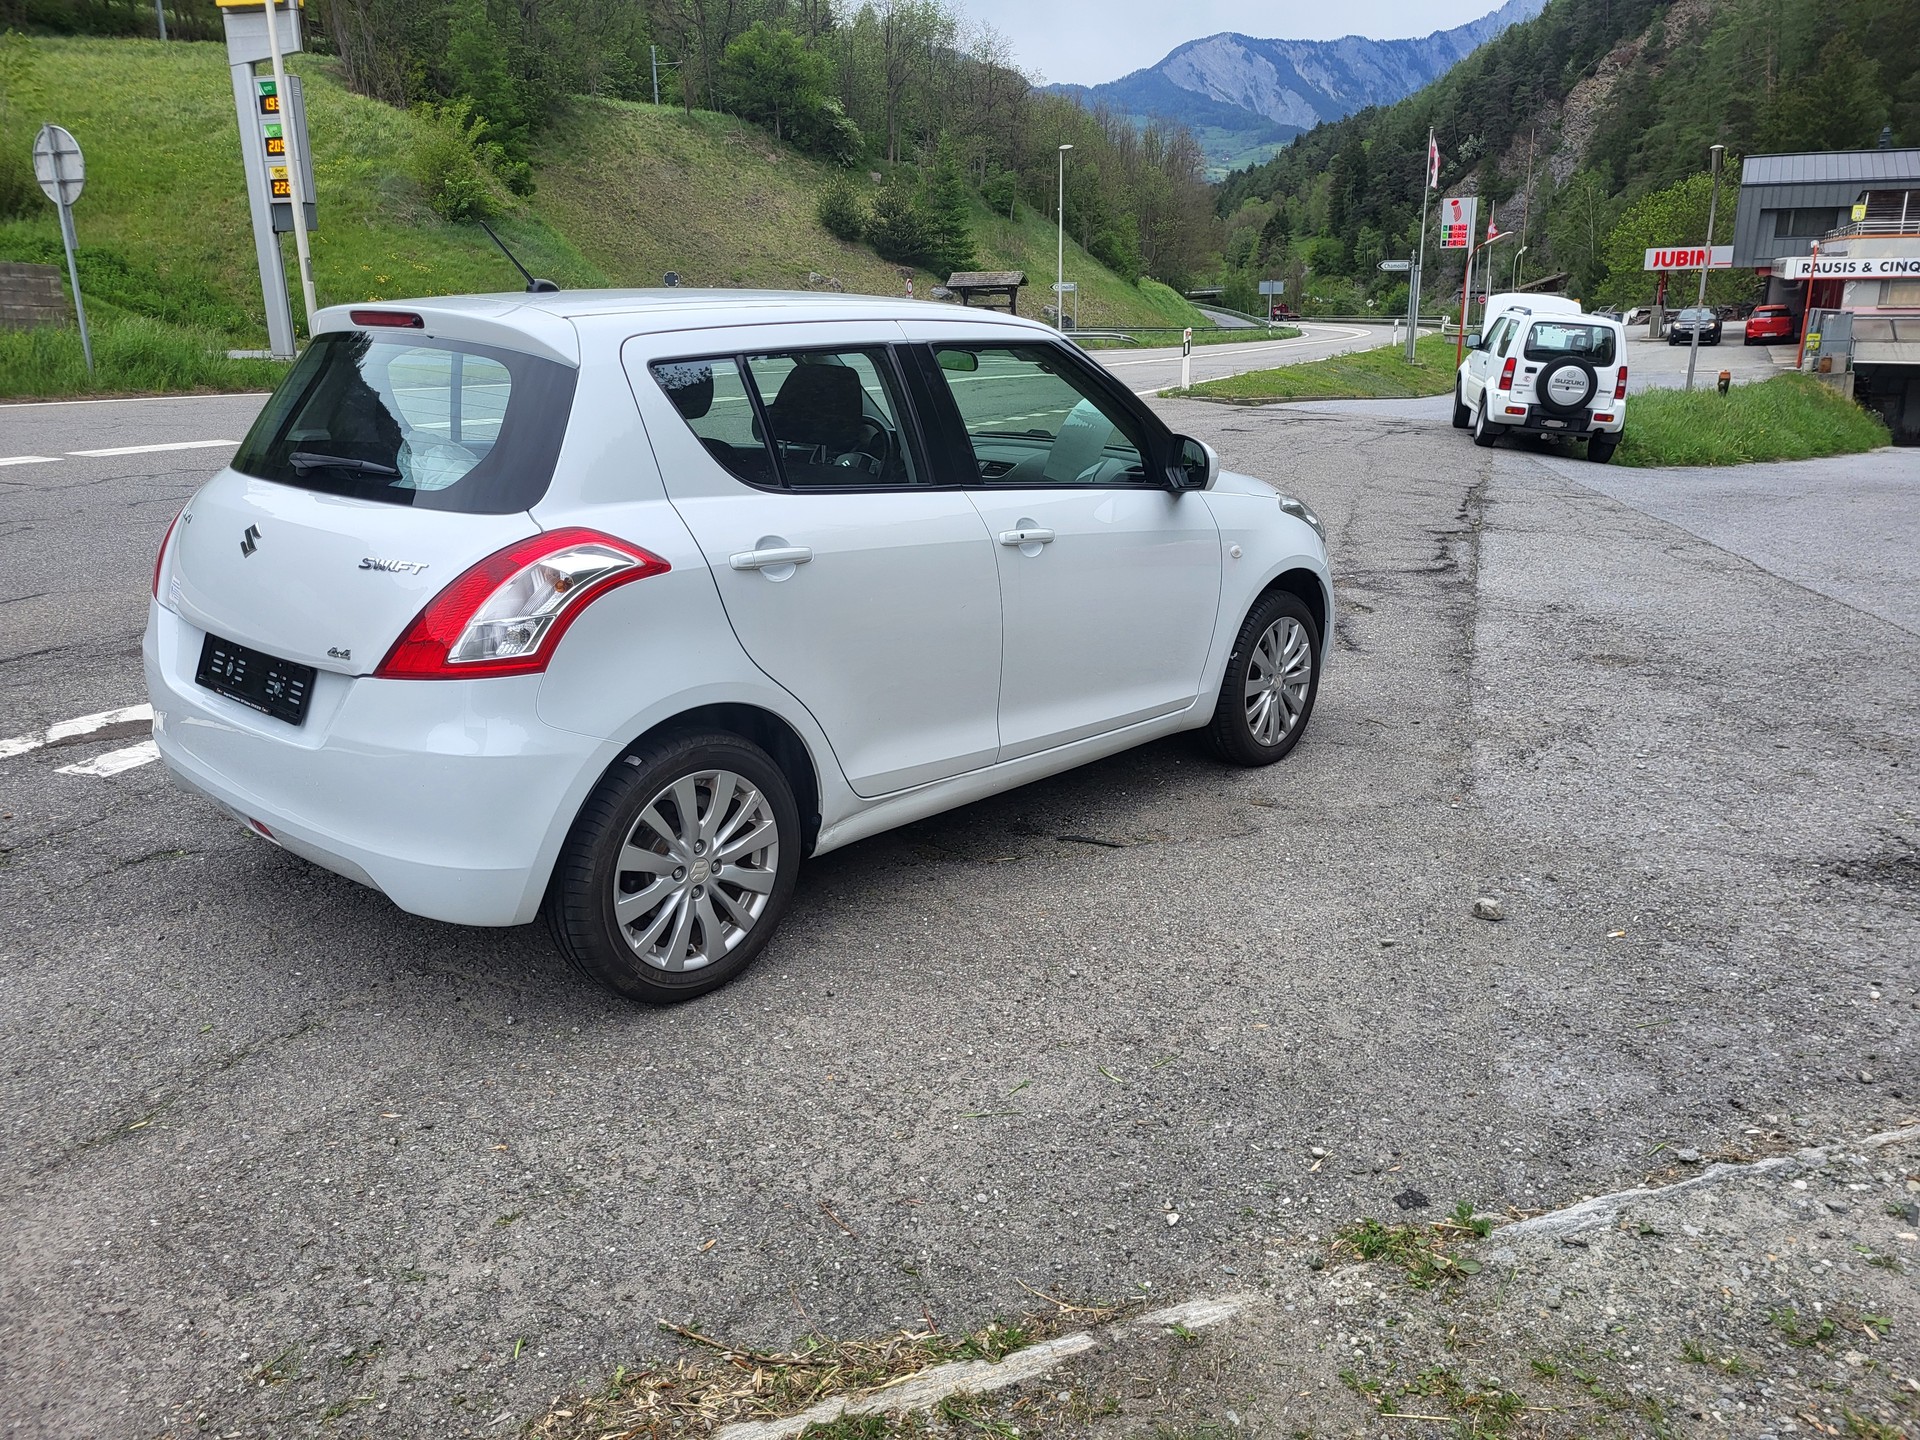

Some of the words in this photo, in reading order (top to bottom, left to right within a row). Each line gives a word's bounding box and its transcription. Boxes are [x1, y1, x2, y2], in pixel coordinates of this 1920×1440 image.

[1653, 250, 1711, 267] JUBIN
[1801, 262, 1856, 273] RAUSIS
[1861, 261, 1873, 273] &
[1554, 378, 1585, 386] SUZUKI
[358, 557, 430, 575] SWIFT
